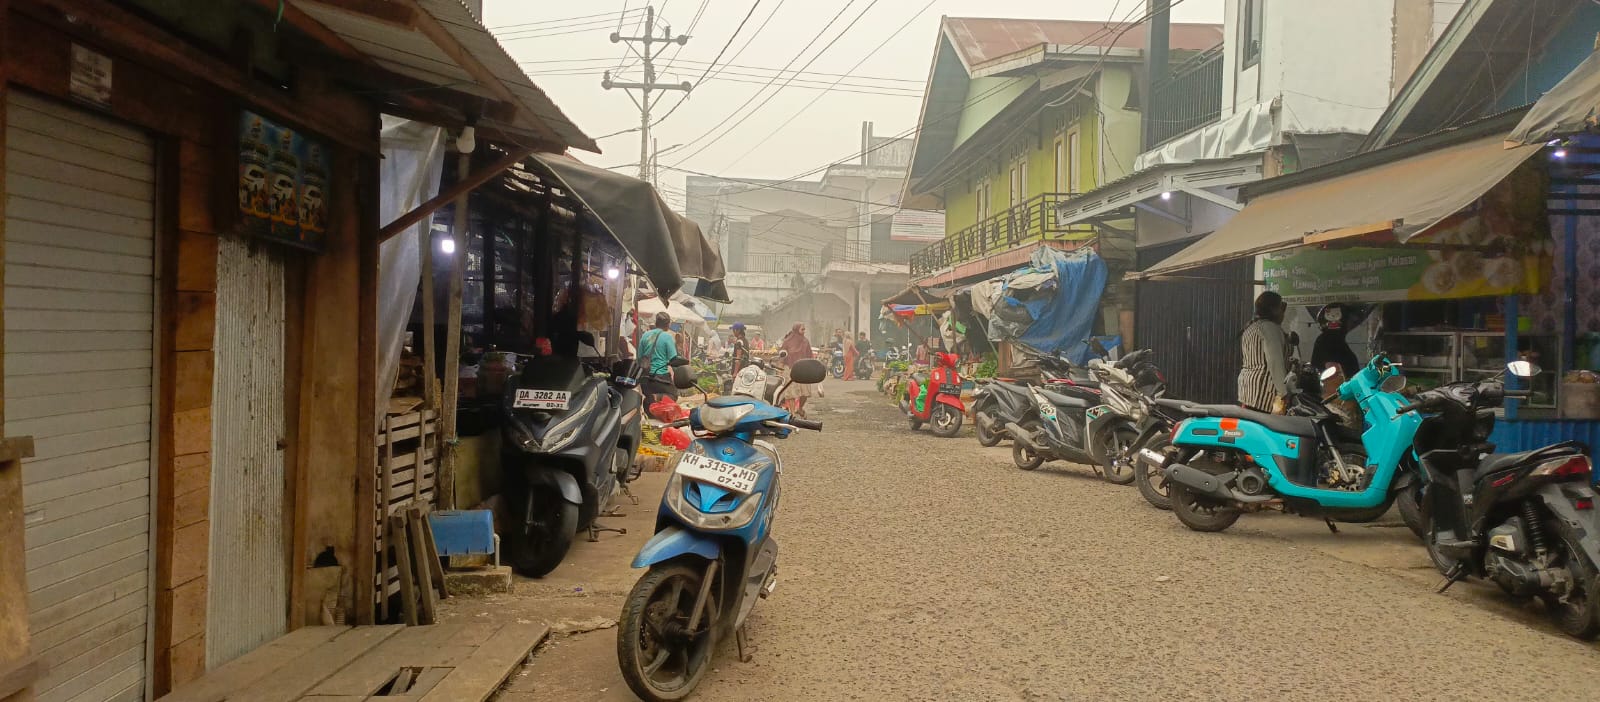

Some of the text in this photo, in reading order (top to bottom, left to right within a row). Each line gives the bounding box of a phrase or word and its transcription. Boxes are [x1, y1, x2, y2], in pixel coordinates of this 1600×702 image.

[519, 390, 567, 401] DA 3282 AA
[682, 453, 756, 482] KH 3157 MD
